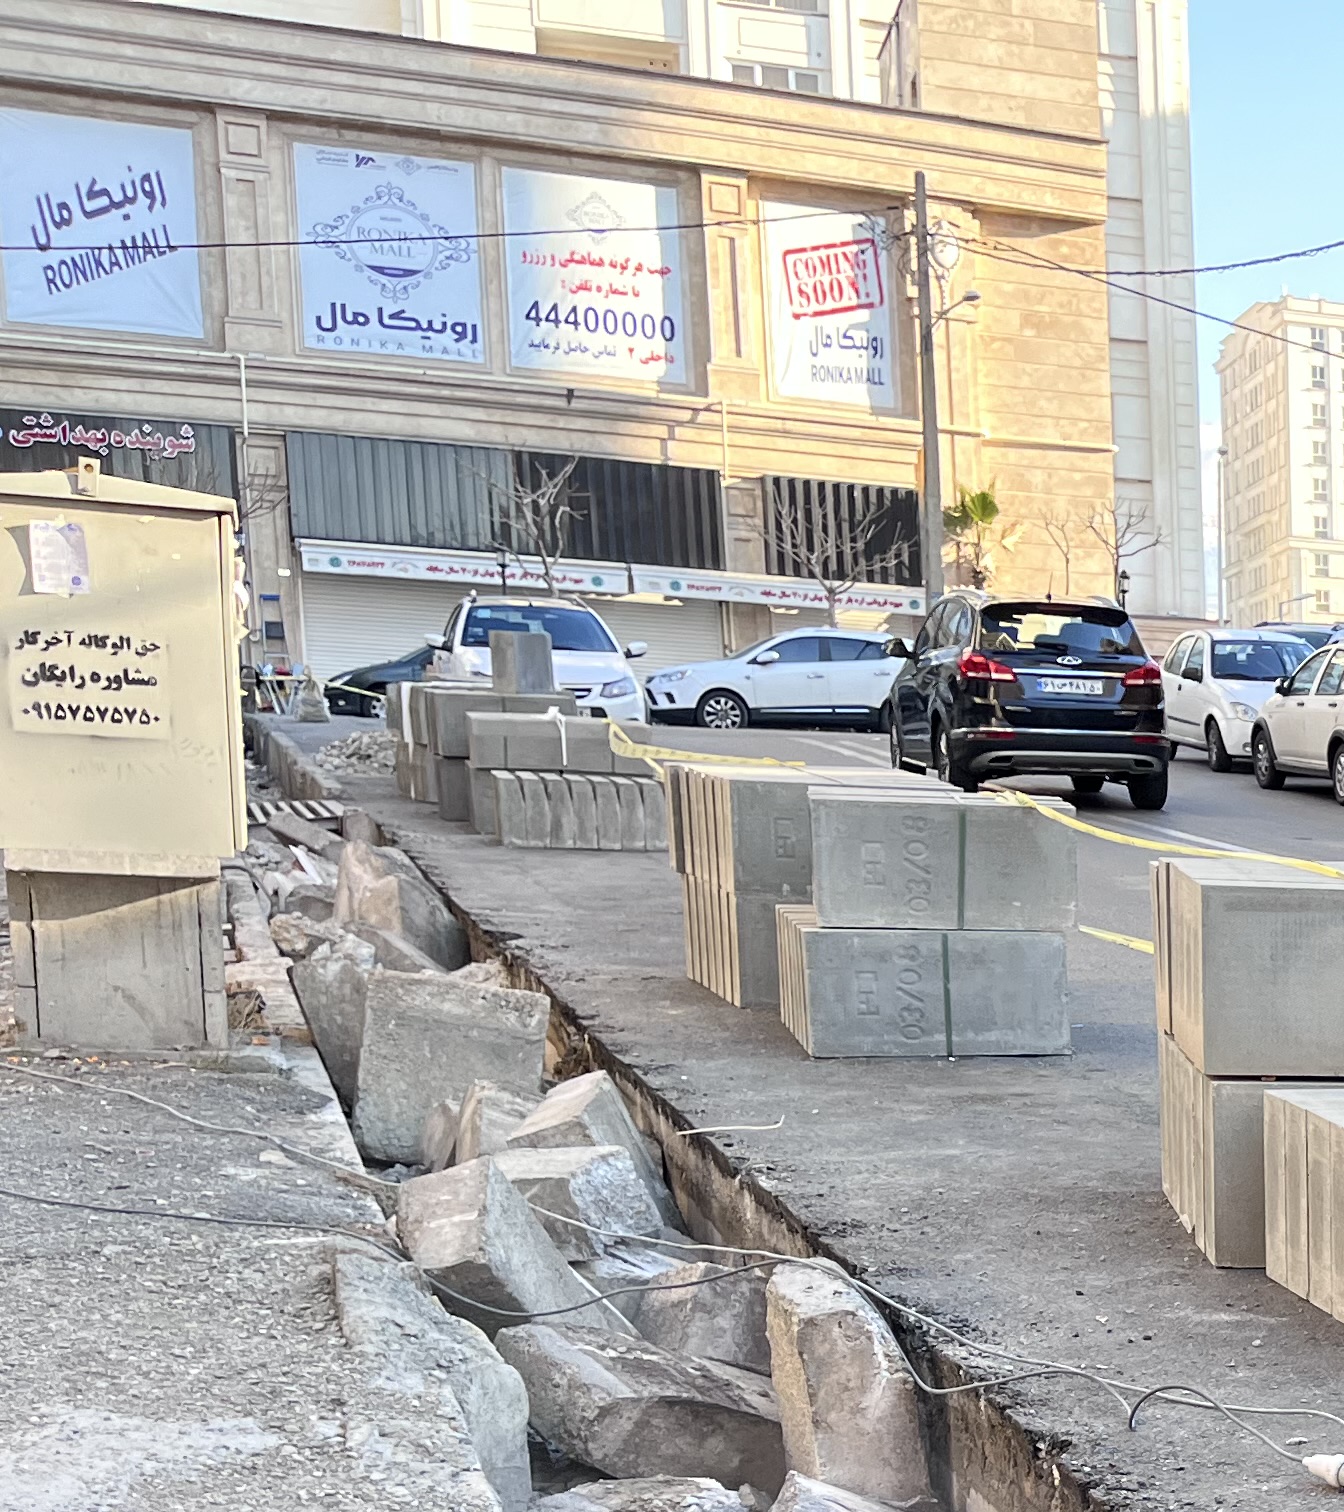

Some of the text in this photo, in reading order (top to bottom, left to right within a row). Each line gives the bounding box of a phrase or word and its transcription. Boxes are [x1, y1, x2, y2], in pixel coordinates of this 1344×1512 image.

[31, 165, 167, 251] رونیکا مال
[792, 250, 867, 281] COMING
[315, 302, 478, 344] رونیکا مال
[525, 300, 675, 342] 44400000
[317, 335, 480, 359] RONIKA MALL
[809, 325, 832, 357] مال
[9, 412, 195, 460] شوینده بهداشتی
[79, 635, 131, 656] الوکاله
[135, 640, 161, 657] حق
[21, 662, 158, 691] مشاوره رایگان
[22, 701, 160, 725] ۰۹۱۵۷۵۷۵۷۵۰
